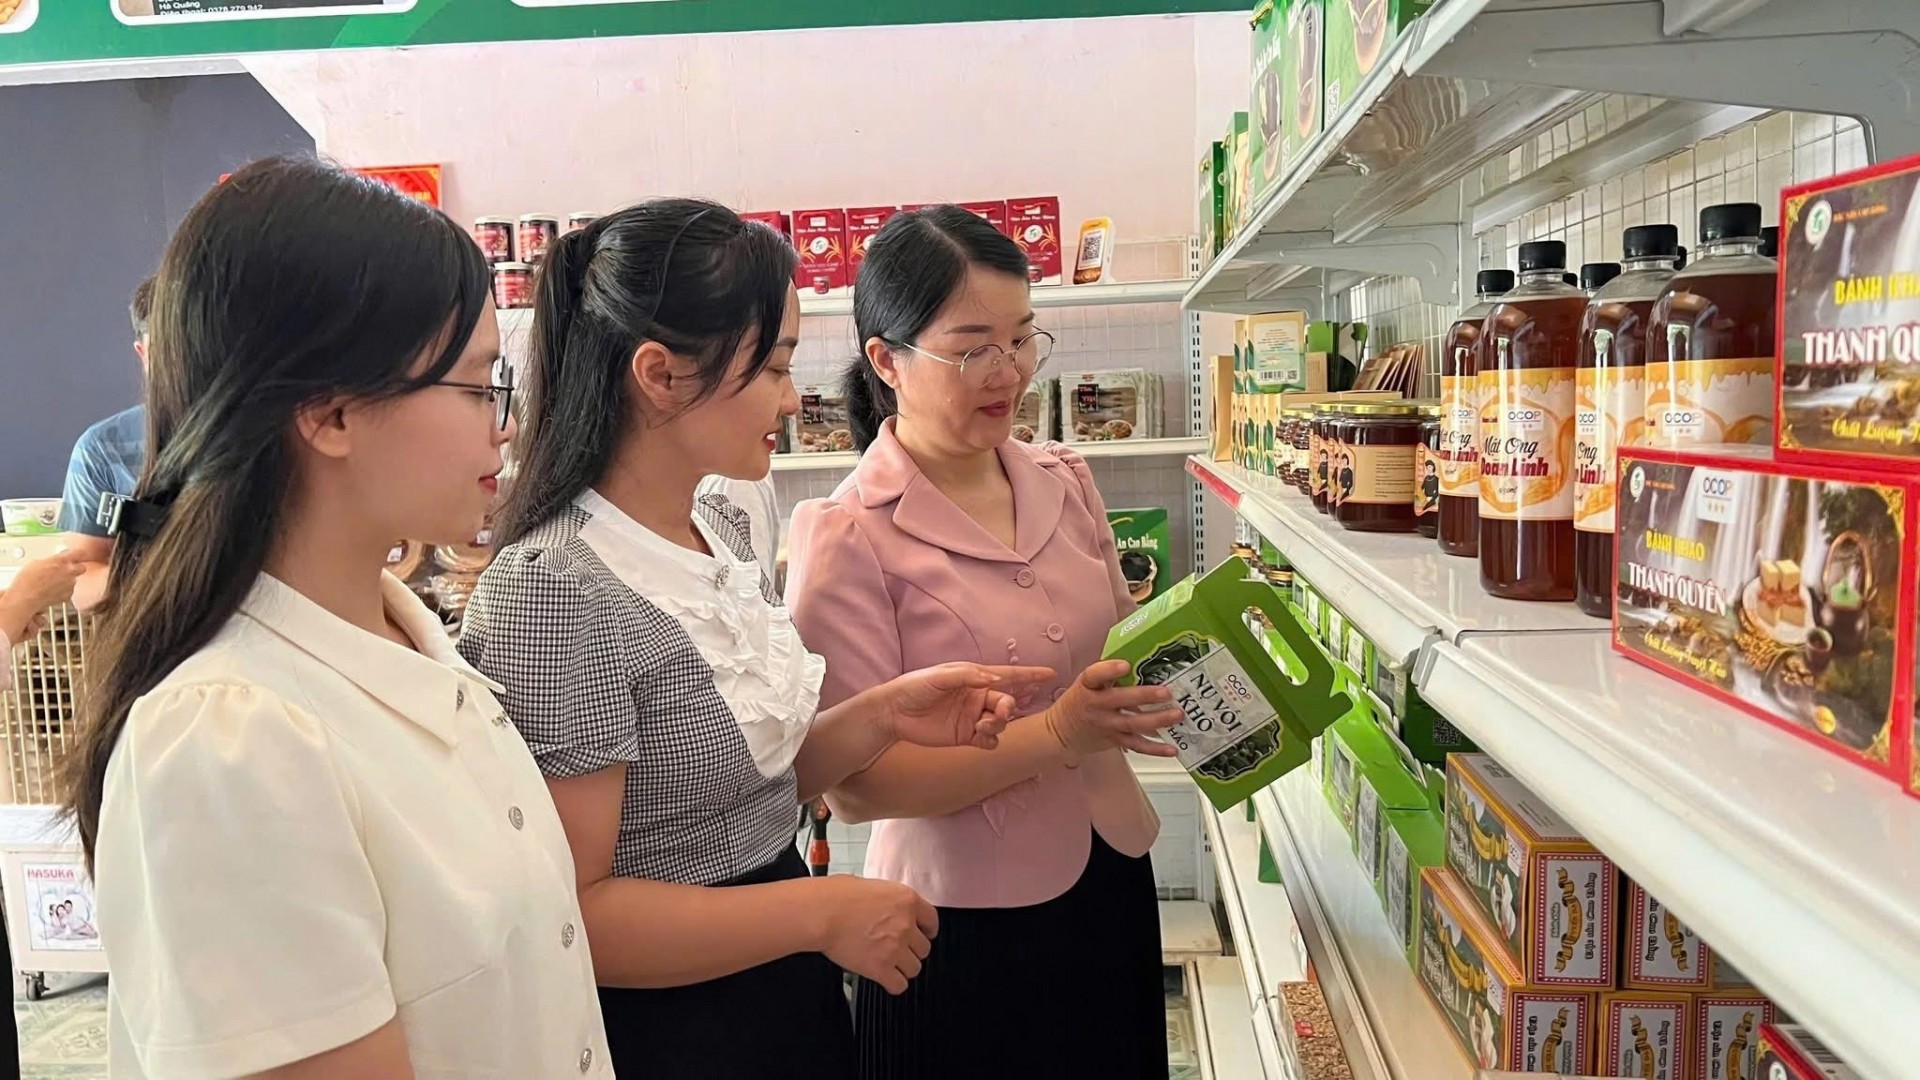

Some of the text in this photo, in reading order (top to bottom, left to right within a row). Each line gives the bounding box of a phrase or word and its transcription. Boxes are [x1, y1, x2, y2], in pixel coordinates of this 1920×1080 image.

[1802, 328, 1886, 364] THANH
[1508, 410, 1541, 420] OCOP
[1511, 457, 1549, 477] Linh
[1703, 477, 1732, 495] OCOP
[1228, 674, 1252, 701] OCOP
[1177, 693, 1214, 732] KHÔ
